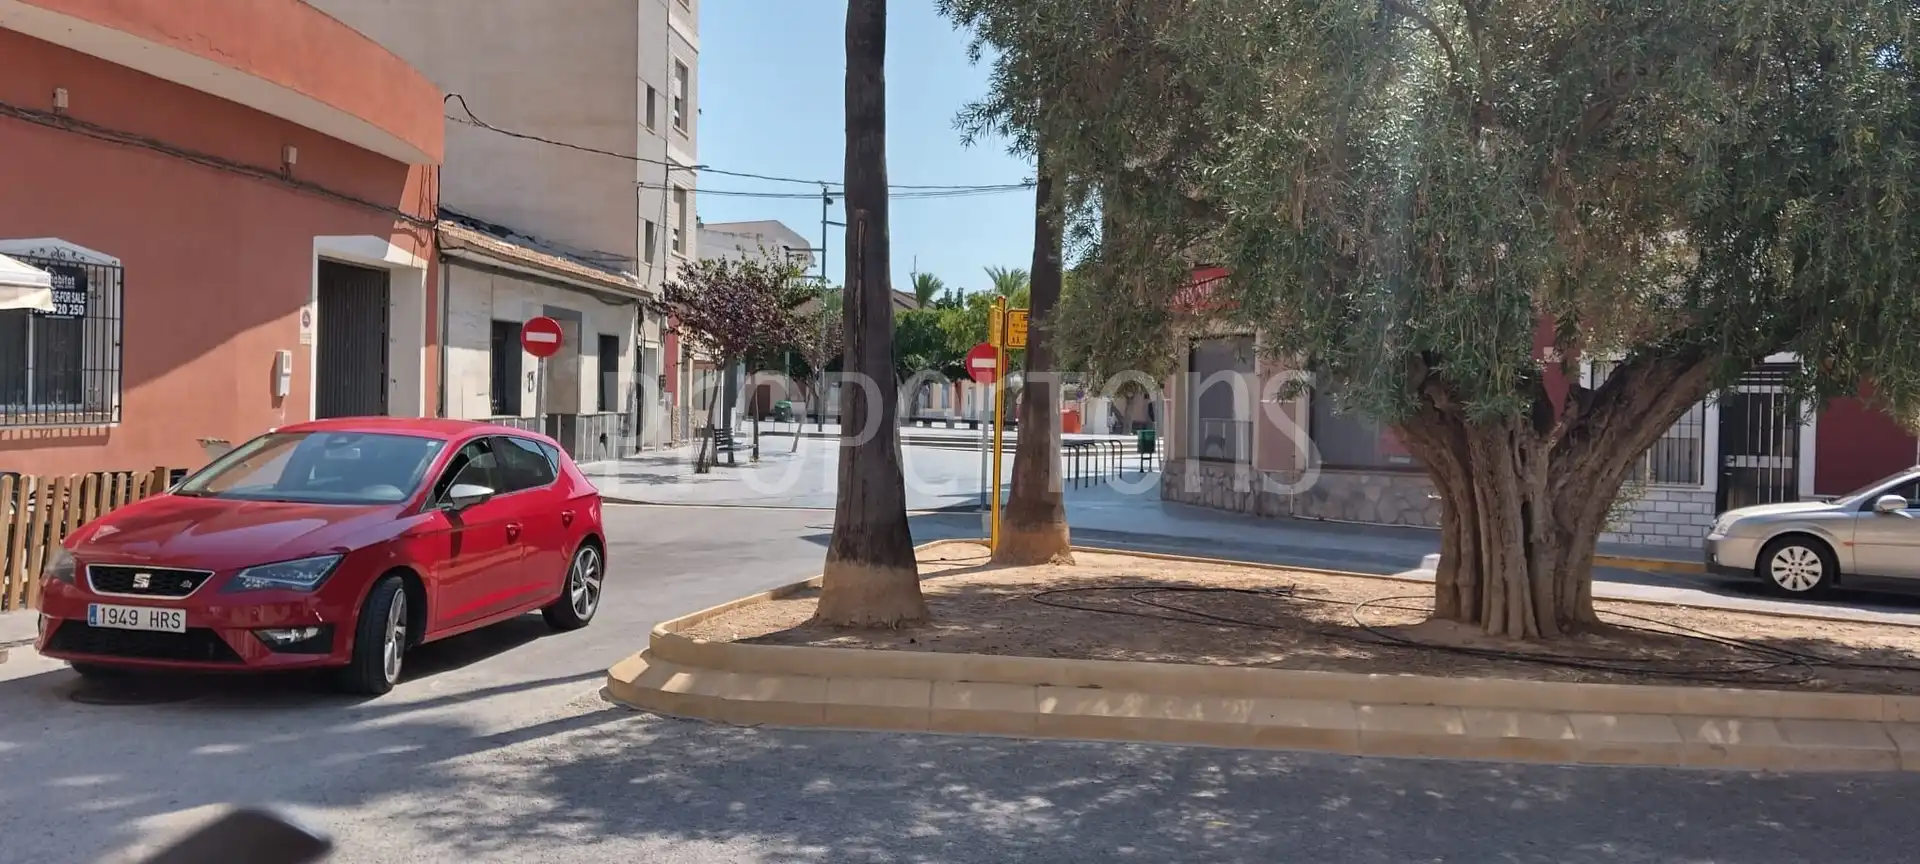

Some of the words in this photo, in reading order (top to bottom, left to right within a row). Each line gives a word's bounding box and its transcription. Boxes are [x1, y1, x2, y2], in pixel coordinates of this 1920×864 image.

[72, 292, 86, 304] SALE
[69, 304, 84, 316] 250
[101, 607, 138, 626] 1949
[150, 610, 181, 629] HRS
